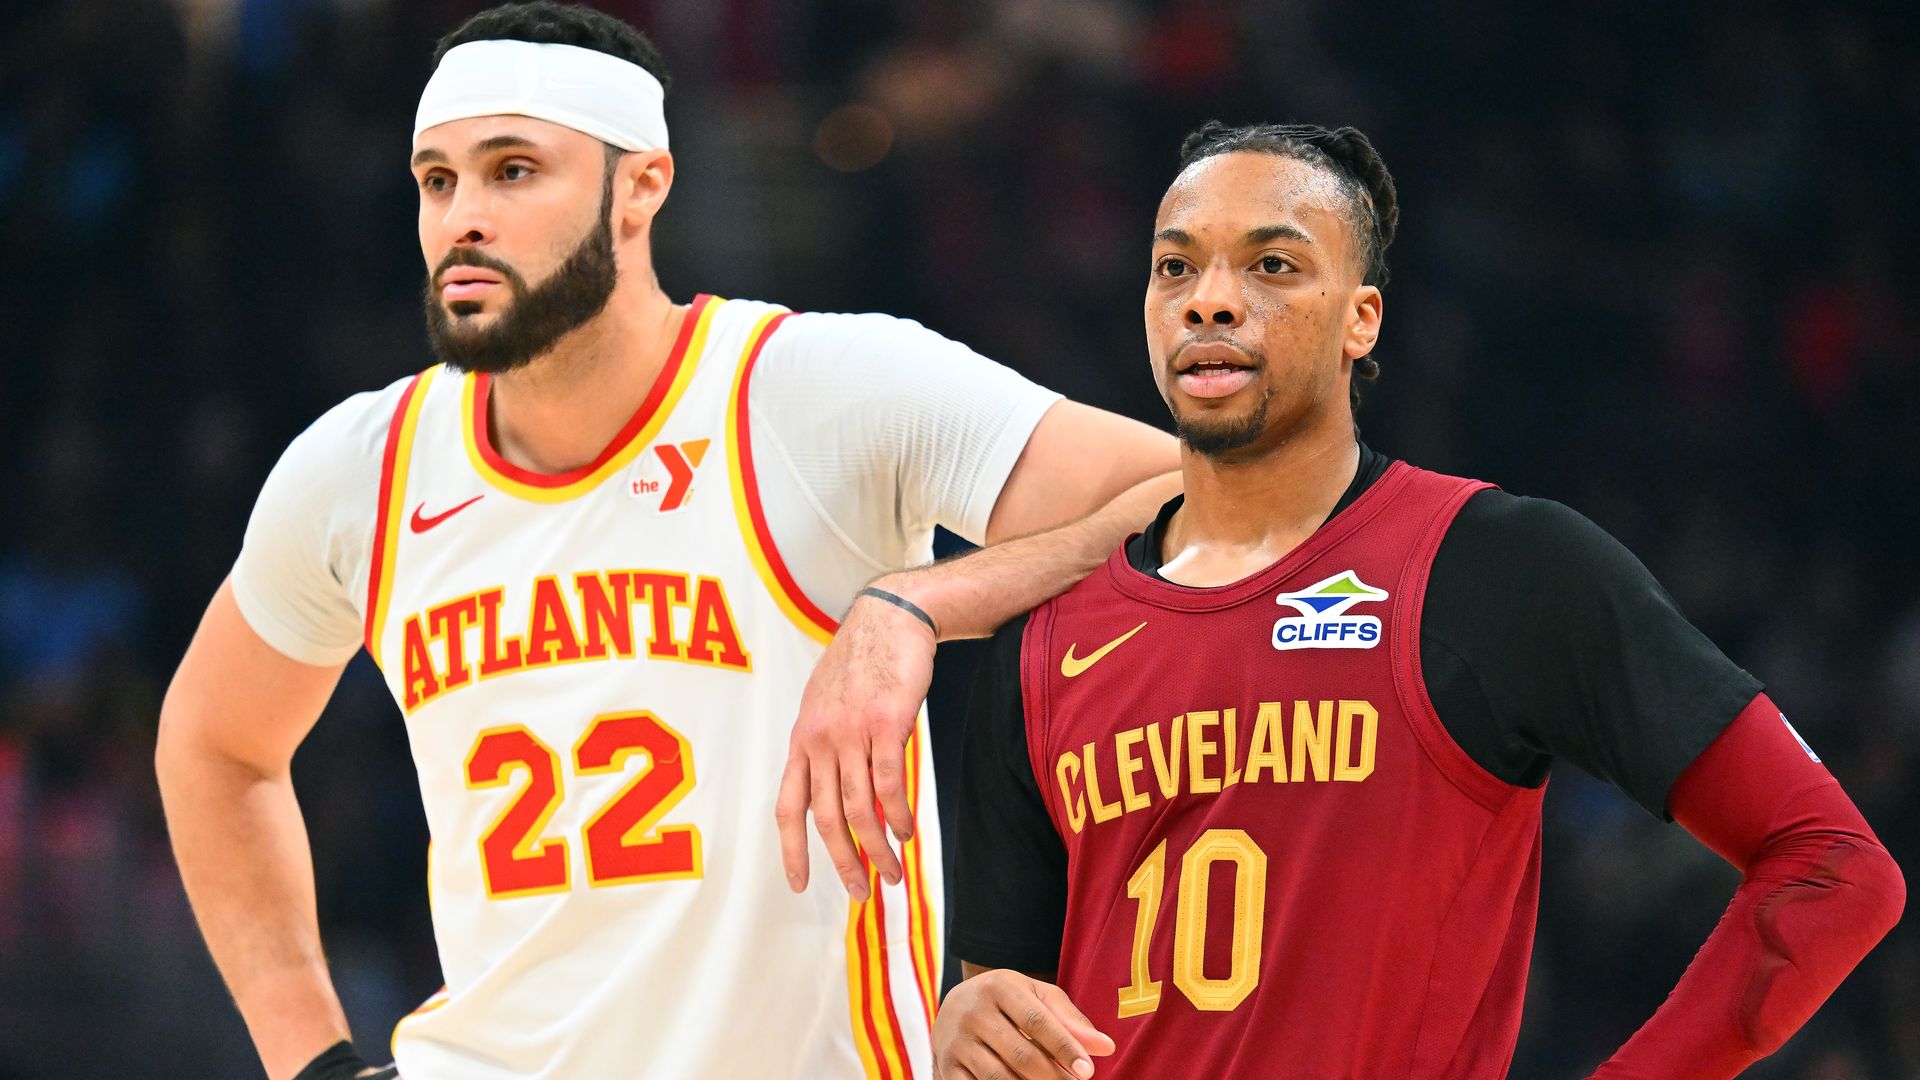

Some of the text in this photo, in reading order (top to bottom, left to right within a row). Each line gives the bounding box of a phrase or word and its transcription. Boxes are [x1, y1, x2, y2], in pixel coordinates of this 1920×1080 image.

[632, 479, 659, 495] the
[403, 569, 753, 716] ATLANTA
[1276, 622, 1378, 643] CLIFFS
[463, 709, 704, 900] 22
[1056, 700, 1379, 835] CLEVELAND
[1117, 829, 1268, 1019] 10
